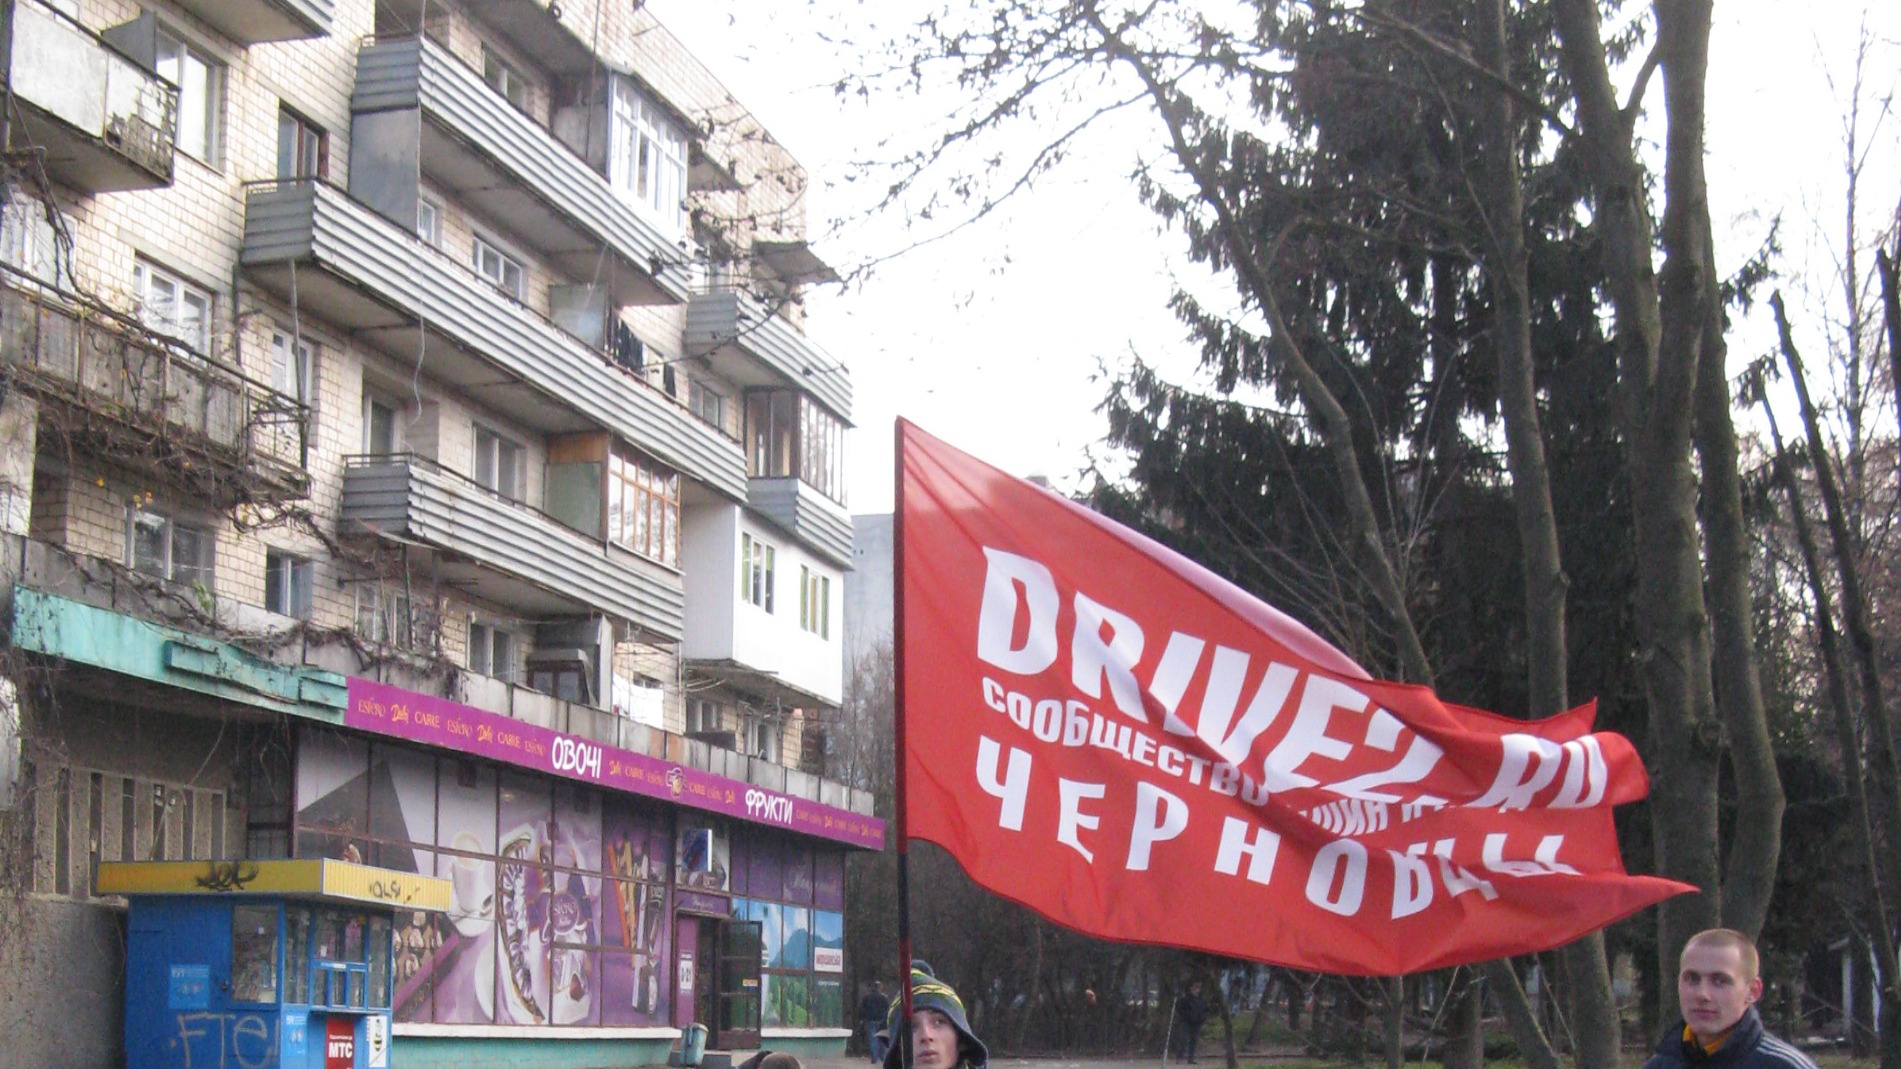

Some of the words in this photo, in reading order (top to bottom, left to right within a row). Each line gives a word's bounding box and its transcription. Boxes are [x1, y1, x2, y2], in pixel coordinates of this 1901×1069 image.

[552, 736, 602, 779] ОВОЧІ
[745, 789, 793, 825] ФРУКТИ
[328, 1041, 353, 1059] МТС
